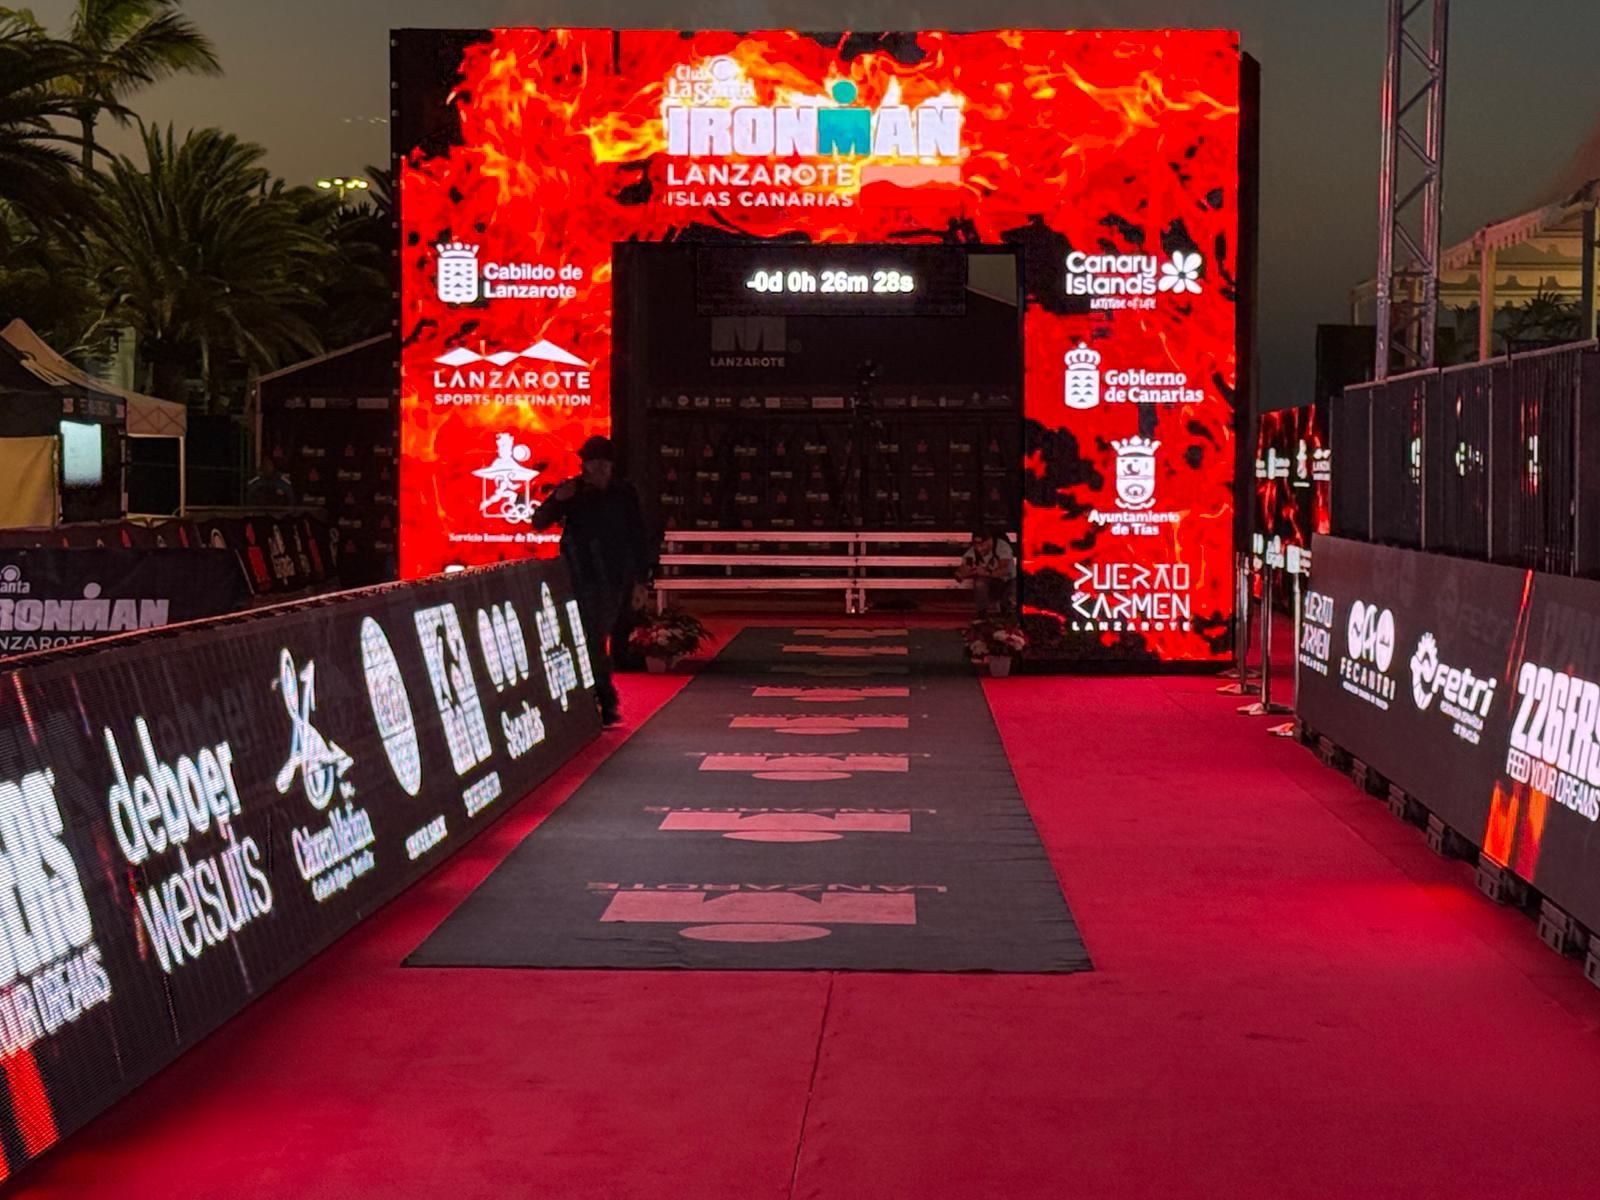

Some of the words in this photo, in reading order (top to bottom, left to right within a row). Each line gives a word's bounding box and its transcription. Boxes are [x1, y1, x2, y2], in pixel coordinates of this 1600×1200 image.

[666, 80, 960, 157] IRONMAN
[666, 163, 855, 186] LANZAROTE
[667, 191, 731, 207] ISLAS
[738, 191, 854, 207] CANARIAS
[483, 262, 556, 280] Cabildo
[559, 263, 583, 280] de
[1065, 251, 1157, 280] Canary
[483, 281, 577, 299] Lanzarote
[787, 270, 816, 292] 0h
[820, 270, 869, 292] 26m
[872, 270, 914, 292] 28s
[1065, 273, 1157, 295] Islands
[710, 356, 786, 368] LANZAROTE
[433, 369, 591, 389] LANZAROTE
[1104, 368, 1187, 386] Gobierno
[434, 393, 490, 406] SPORTS
[494, 393, 592, 406] DESTINATION
[1104, 387, 1126, 403] de
[1128, 387, 1205, 403] Canarias
[1087, 508, 1182, 526] Ayuntamiento
[1111, 523, 1130, 536] de
[0, 580, 31, 594] anta
[0, 582, 170, 632] RONMAN
[1071, 592, 1191, 620] CARMEN
[1071, 620, 1192, 632] LANZAROTE
[1505, 746, 1531, 775] FEED
[1529, 758, 1558, 800] YOUR
[103, 715, 242, 865] deboer
[135, 820, 273, 974] wetsuits
